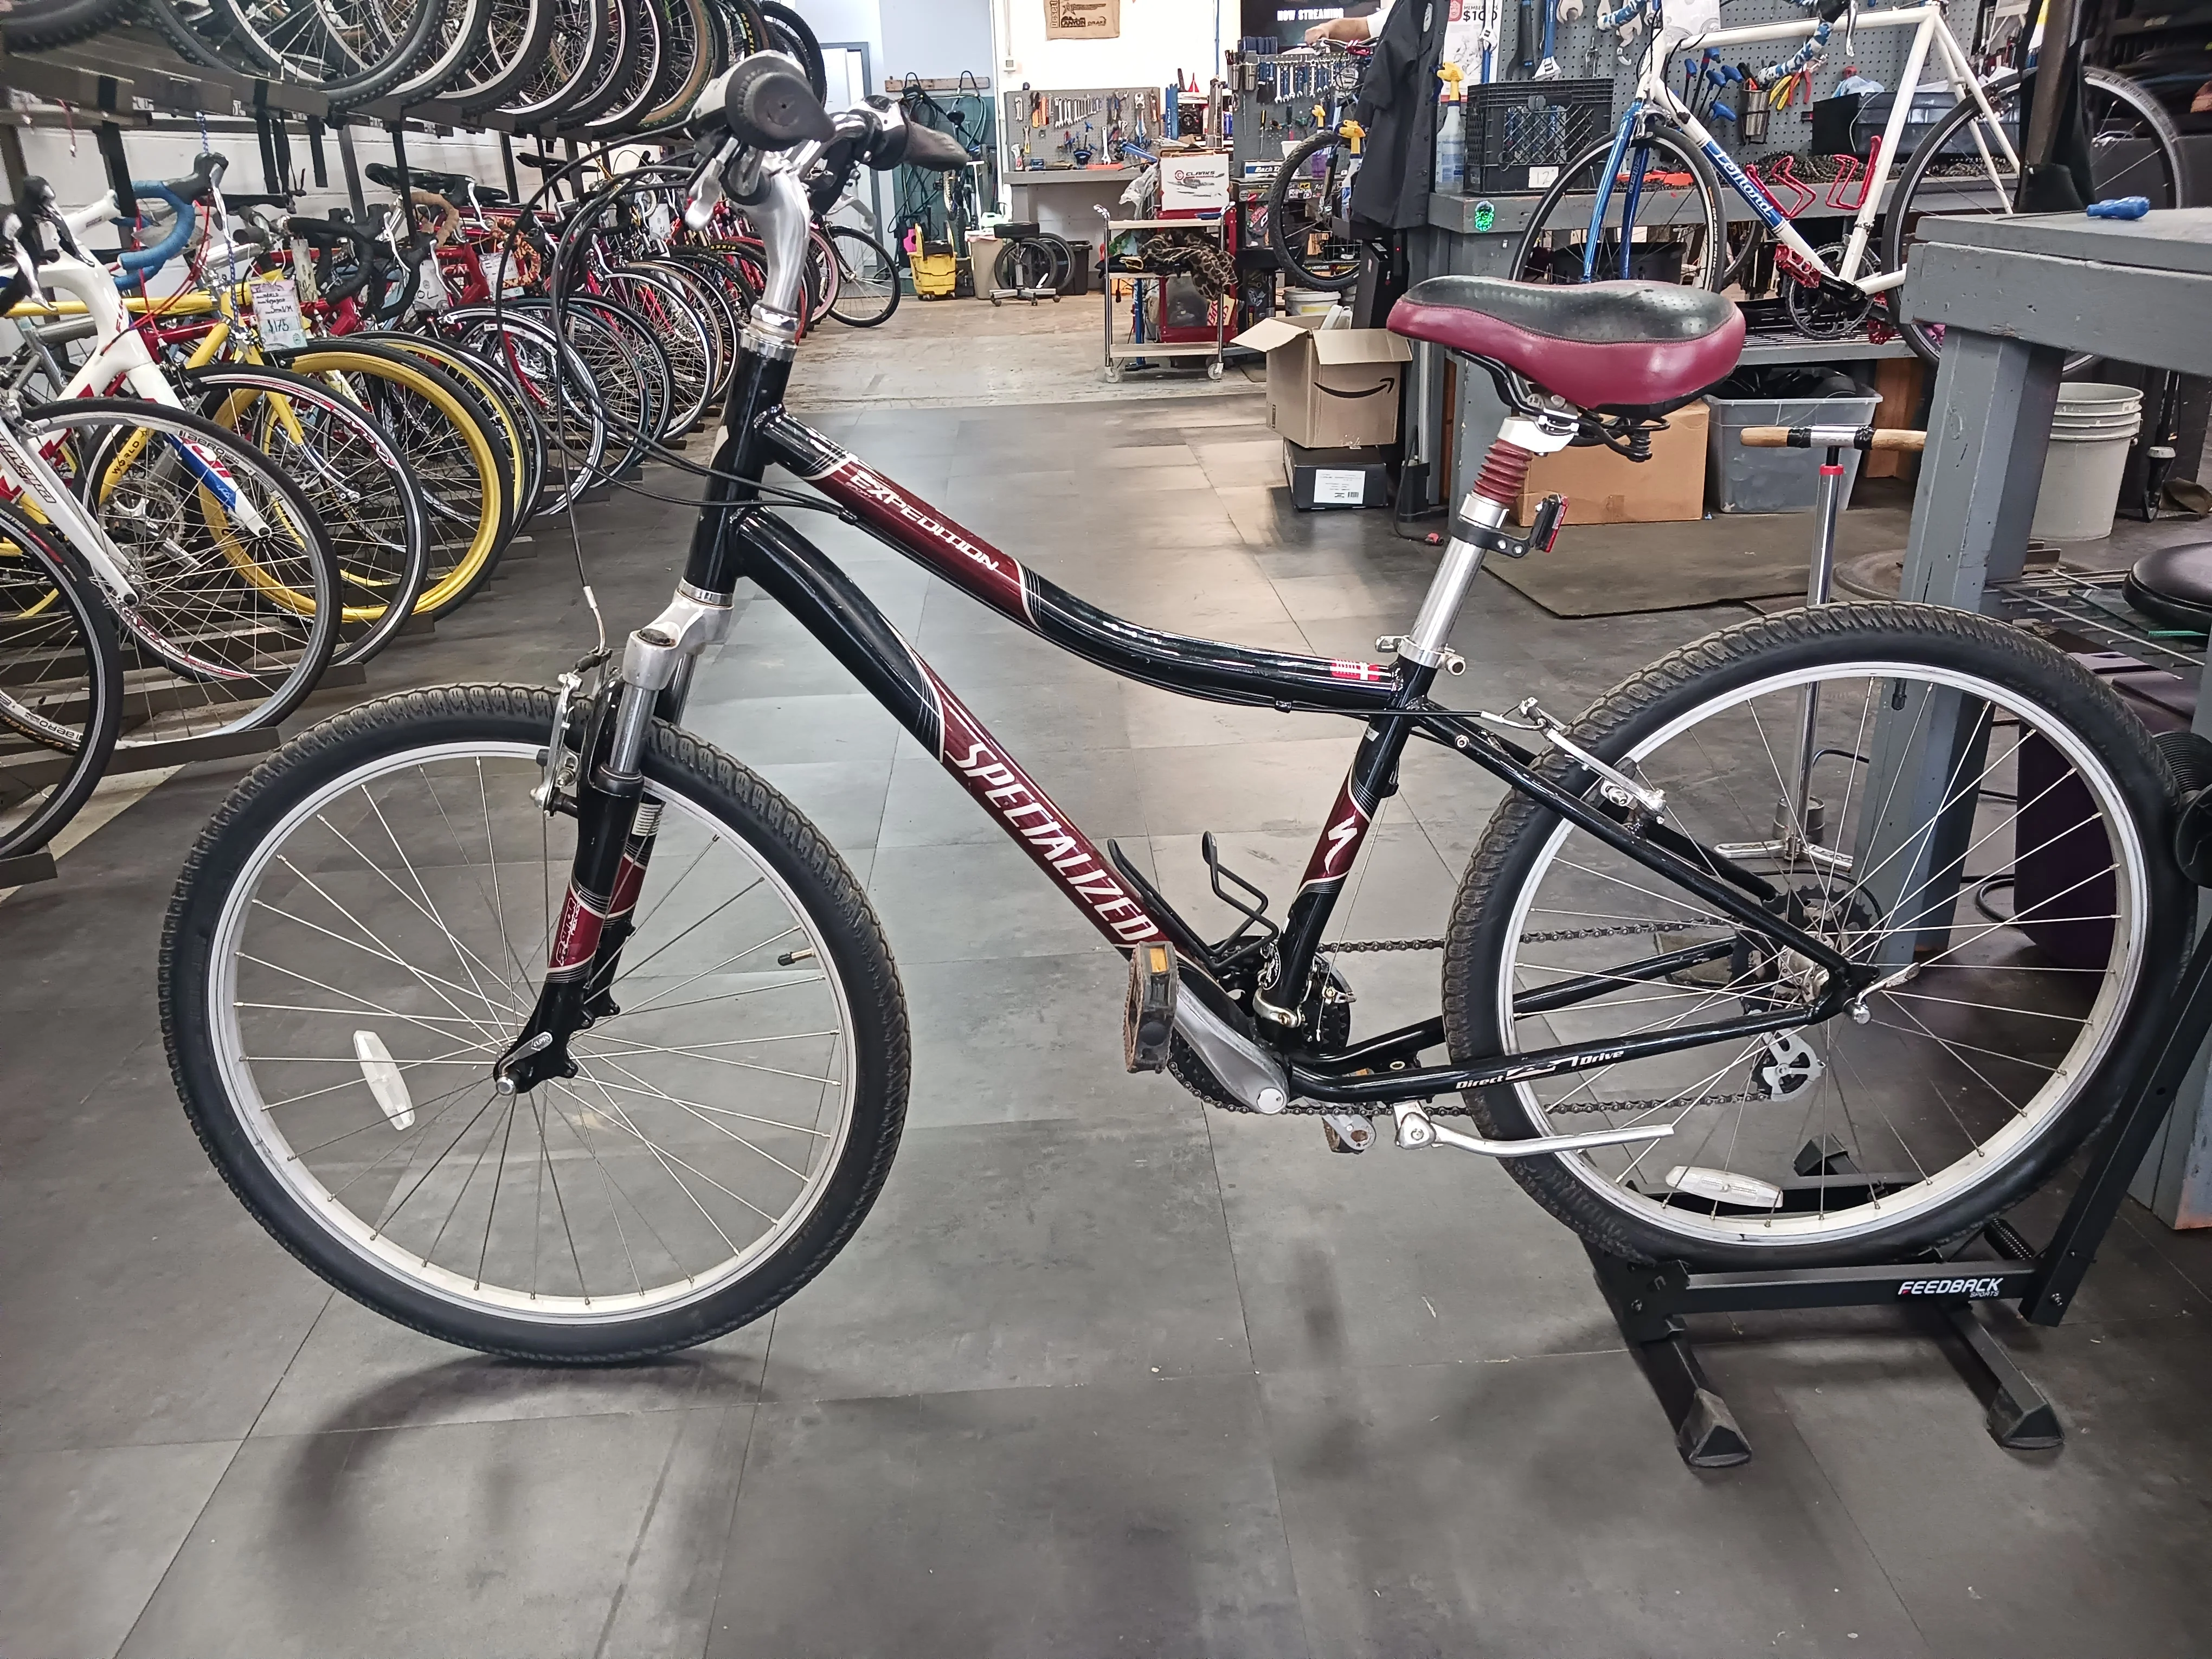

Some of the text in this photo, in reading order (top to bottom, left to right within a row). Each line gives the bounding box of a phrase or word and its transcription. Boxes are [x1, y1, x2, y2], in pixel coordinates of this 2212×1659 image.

[1277, 8, 1344, 21] NOW STREAMING
[112, 441, 140, 475] WORLD
[850, 471, 999, 571] EXPEDITION
[944, 741, 1159, 941] SPECIALIZED
[1456, 1075, 1504, 1090] Direct
[1579, 1050, 1625, 1065] Drive
[1898, 1277, 2004, 1295] FEEDBACK
[1969, 1290, 1999, 1298] SPORTS
